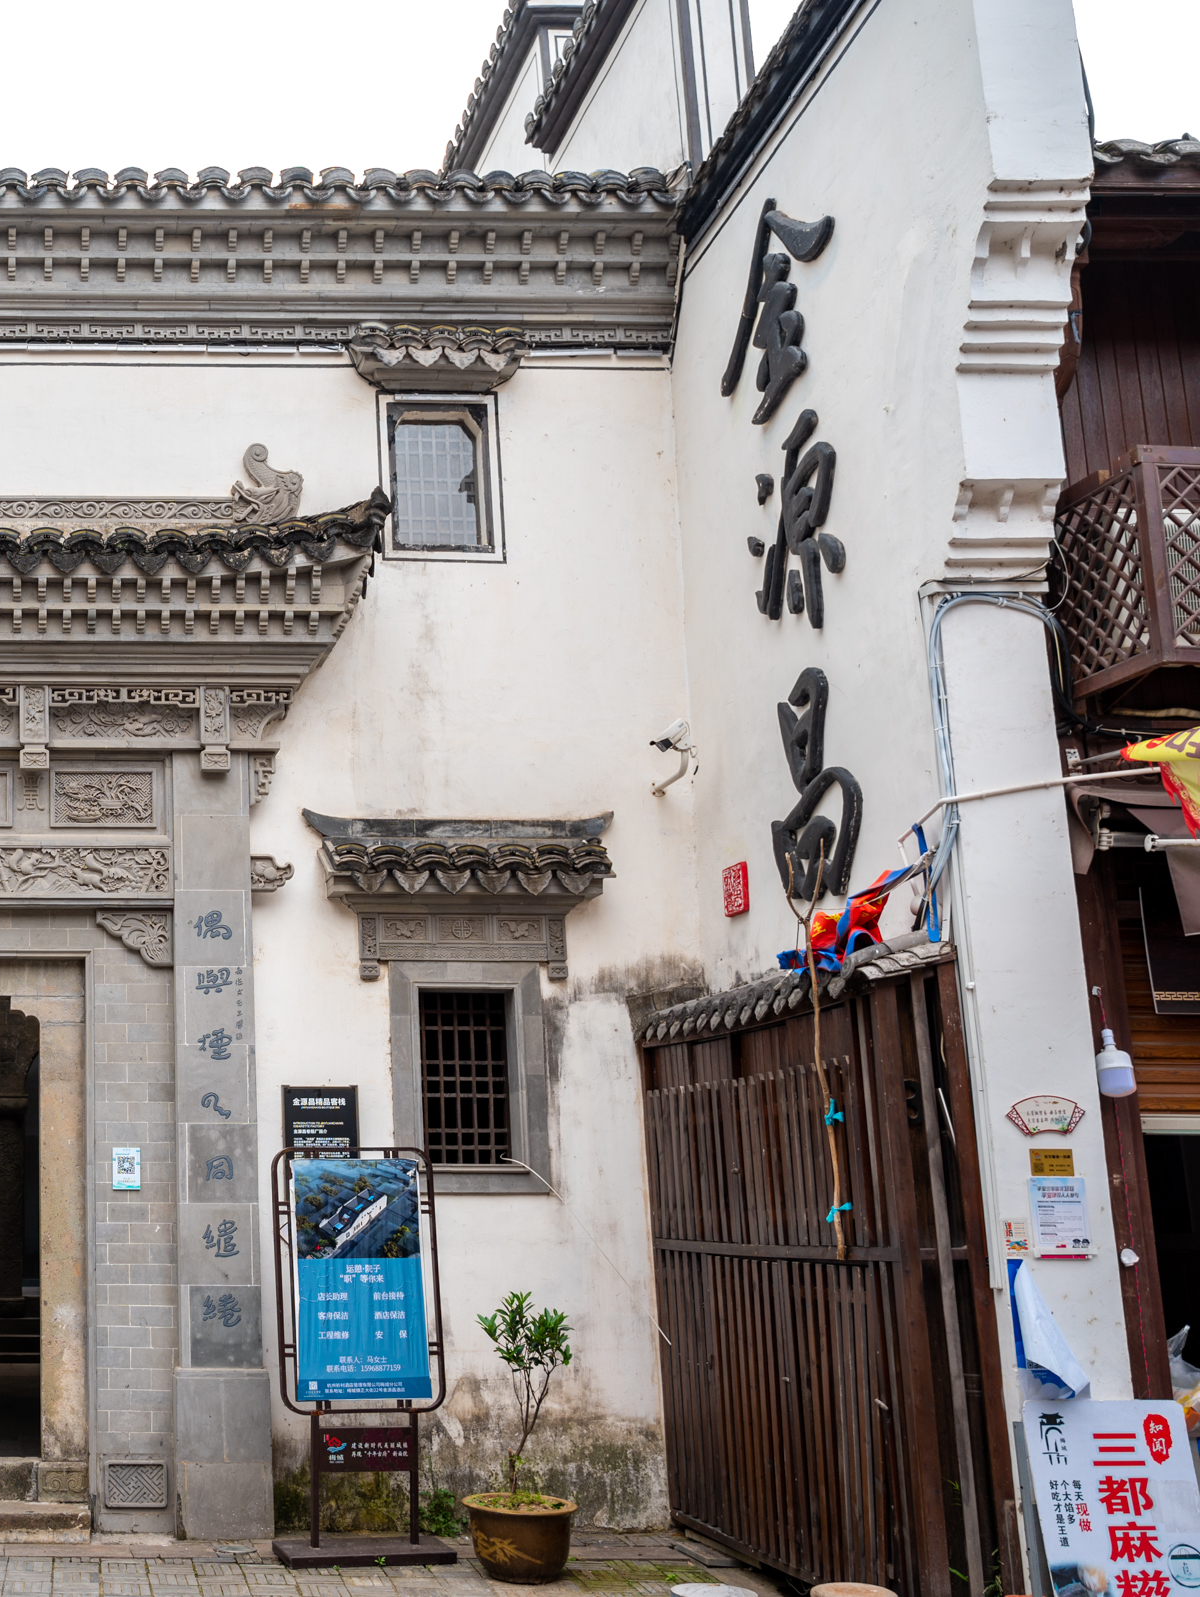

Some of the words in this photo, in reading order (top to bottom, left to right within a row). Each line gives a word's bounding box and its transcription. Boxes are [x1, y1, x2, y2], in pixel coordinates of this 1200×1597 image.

[317, 1292, 348, 1301] 店长助理
[373, 1292, 405, 1300] 前台接待
[318, 1312, 349, 1320] 客房保洁
[374, 1311, 406, 1320] 酒店保洁
[318, 1331, 349, 1340] 工程维修
[1060, 1480, 1076, 1525] 个大馅多
[1072, 1480, 1093, 1532] 每天现做
[1049, 1480, 1070, 1547] 好吃才是王道
